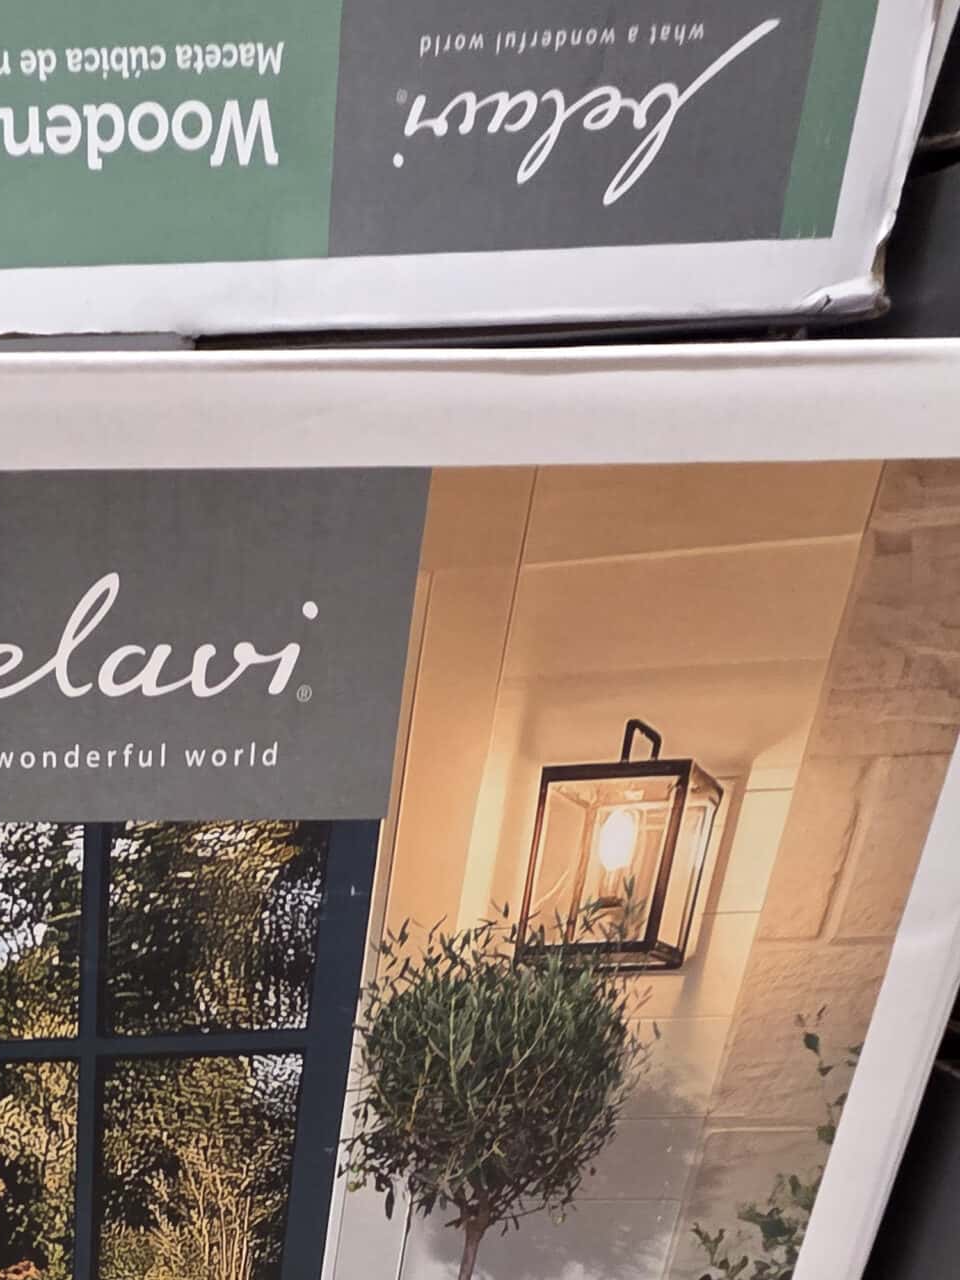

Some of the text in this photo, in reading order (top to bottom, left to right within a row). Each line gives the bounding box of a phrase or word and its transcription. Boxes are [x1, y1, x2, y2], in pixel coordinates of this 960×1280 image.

[420, 23, 704, 56] what a wonderful world
[20, 49, 57, 82] de
[66, 45, 166, 80] cúbica
[176, 42, 284, 75] Maceta
[393, 18, 780, 206] belavi
[185, 741, 279, 768] world
